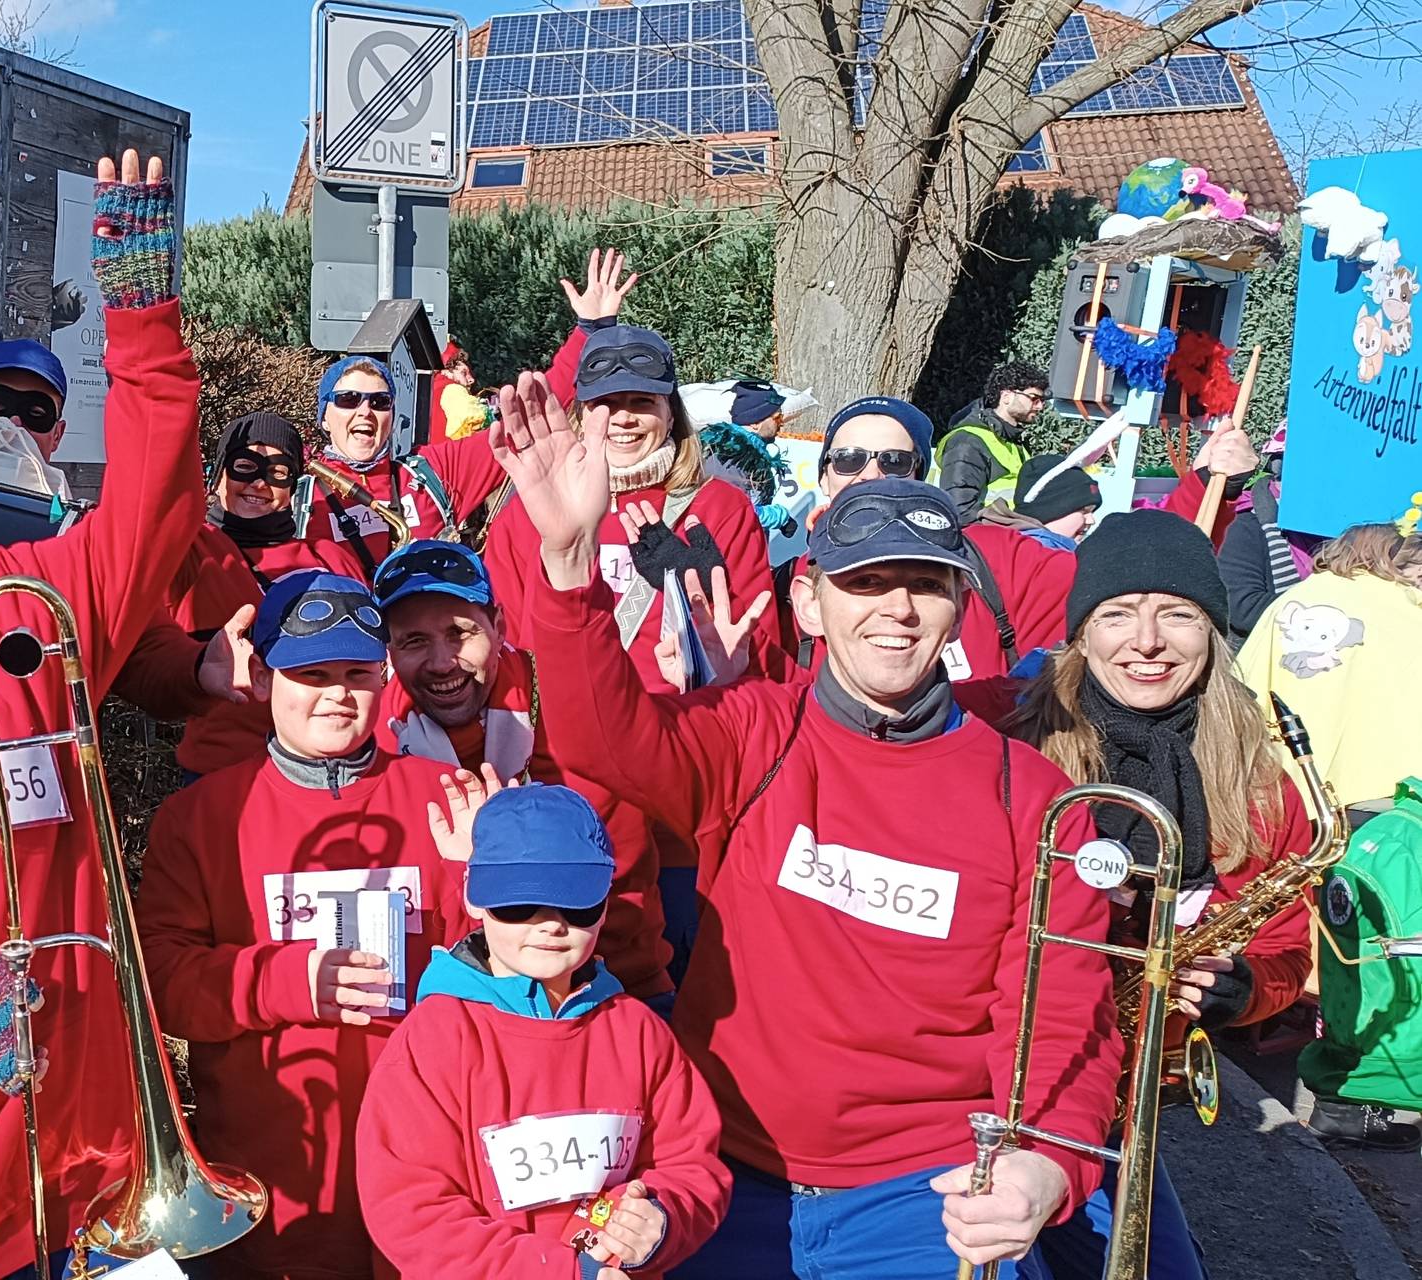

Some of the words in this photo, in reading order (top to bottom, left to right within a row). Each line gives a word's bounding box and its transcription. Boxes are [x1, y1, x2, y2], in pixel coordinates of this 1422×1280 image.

[357, 138, 421, 166] ZONE
[1313, 365, 1422, 458] Artenvielfalt
[794, 848, 940, 920] 334-362
[1078, 856, 1125, 876] CONN
[509, 1135, 633, 1182] 334-125
